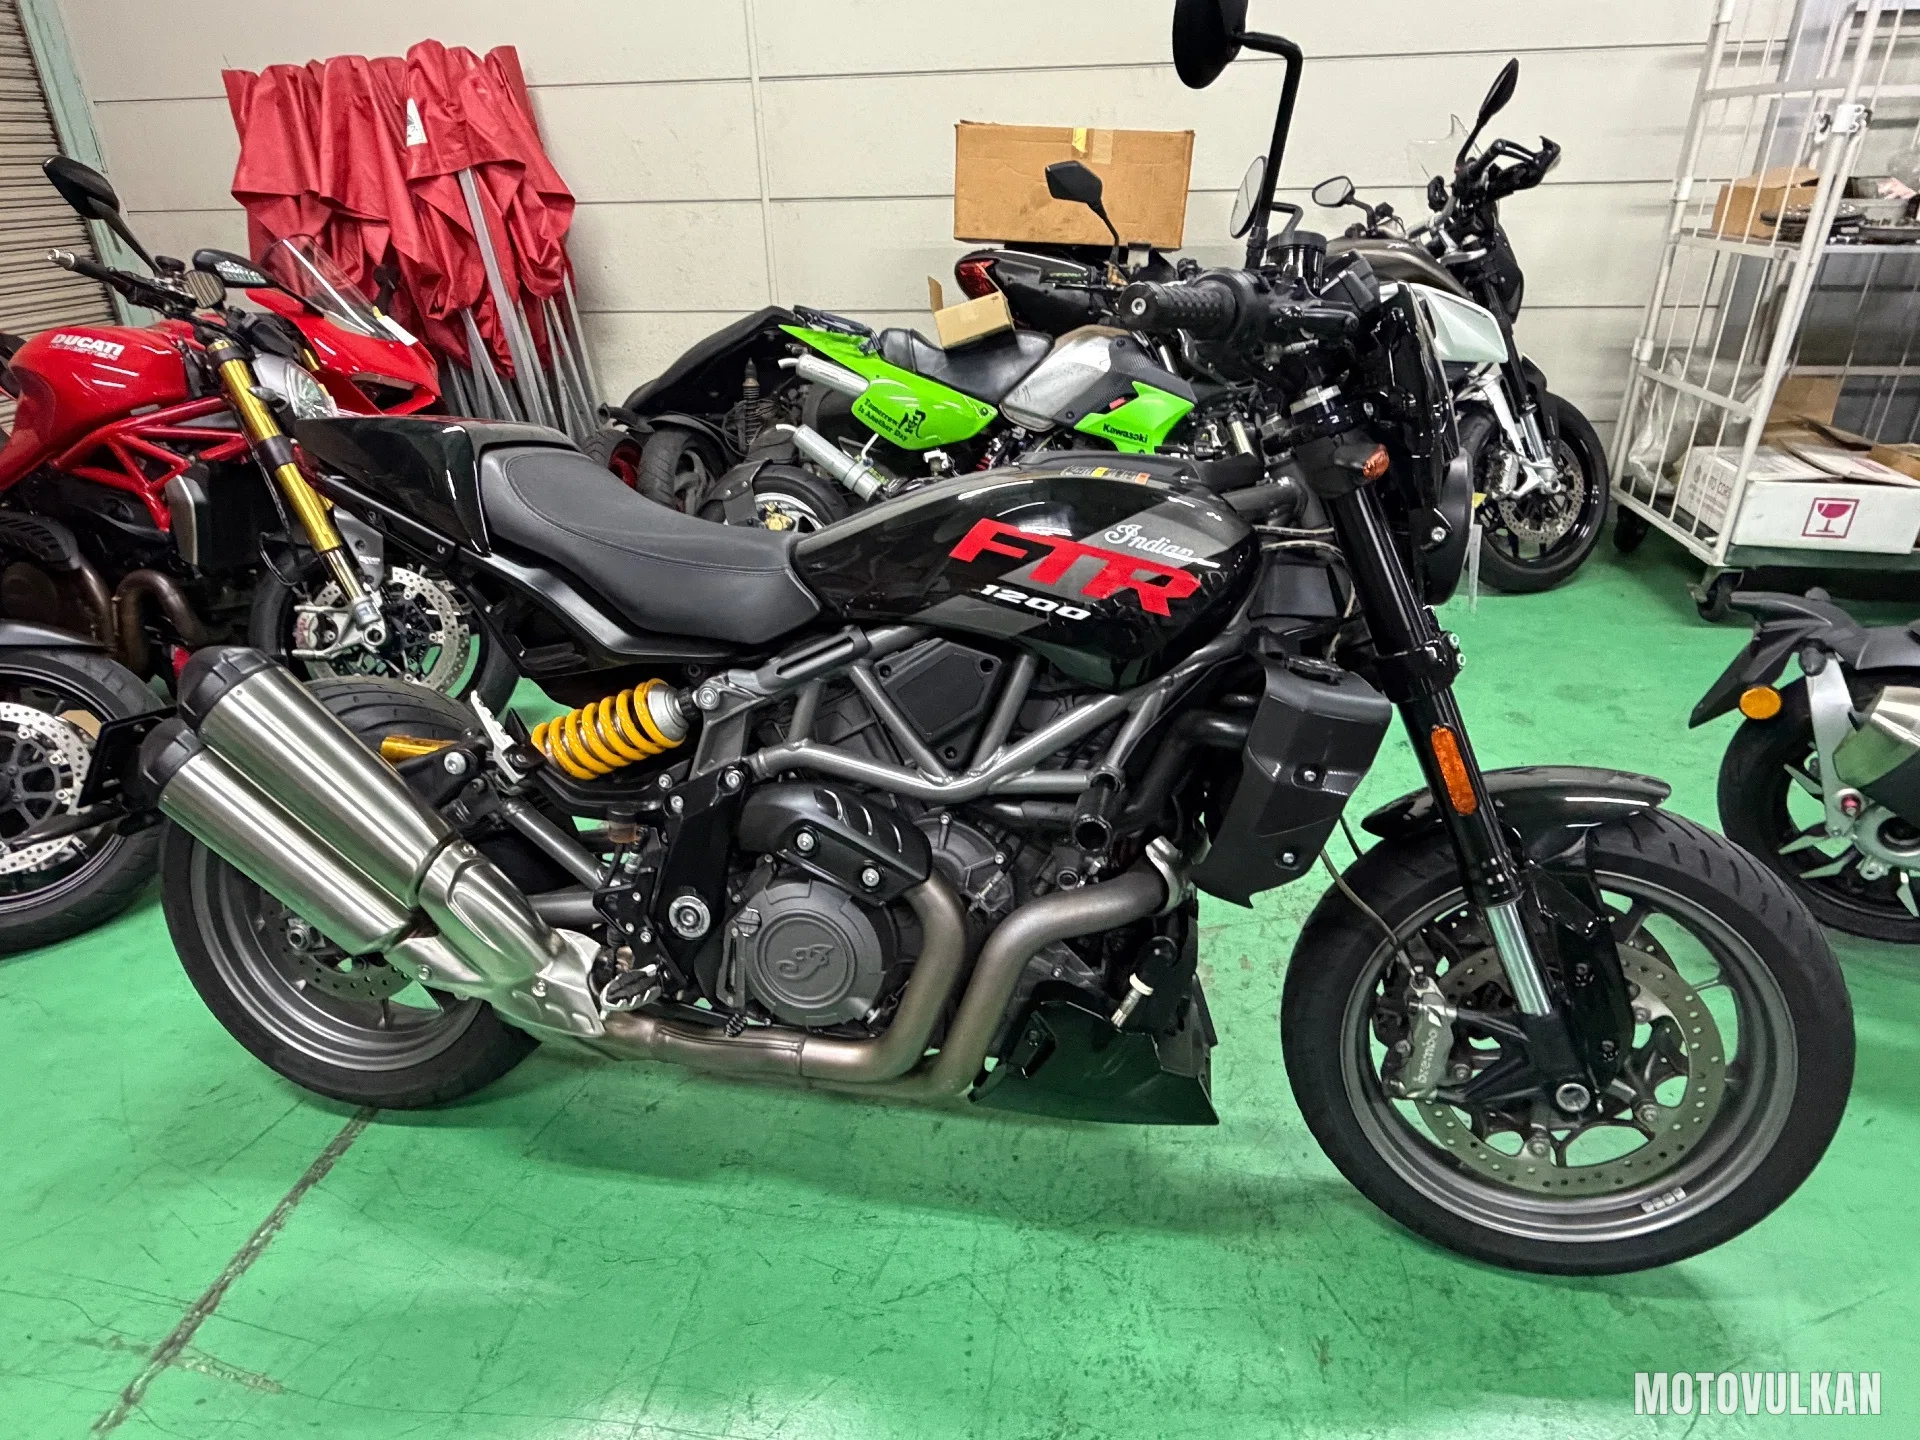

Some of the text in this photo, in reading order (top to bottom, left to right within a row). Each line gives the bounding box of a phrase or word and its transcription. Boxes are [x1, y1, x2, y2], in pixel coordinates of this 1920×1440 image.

[50, 333, 125, 356] DUCATI
[1102, 422, 1149, 443] Kawasaki
[949, 517, 1202, 617] FTR
[1103, 523, 1221, 569] Indian
[979, 583, 1092, 621] 1200
[1413, 1029, 1438, 1083] brembo
